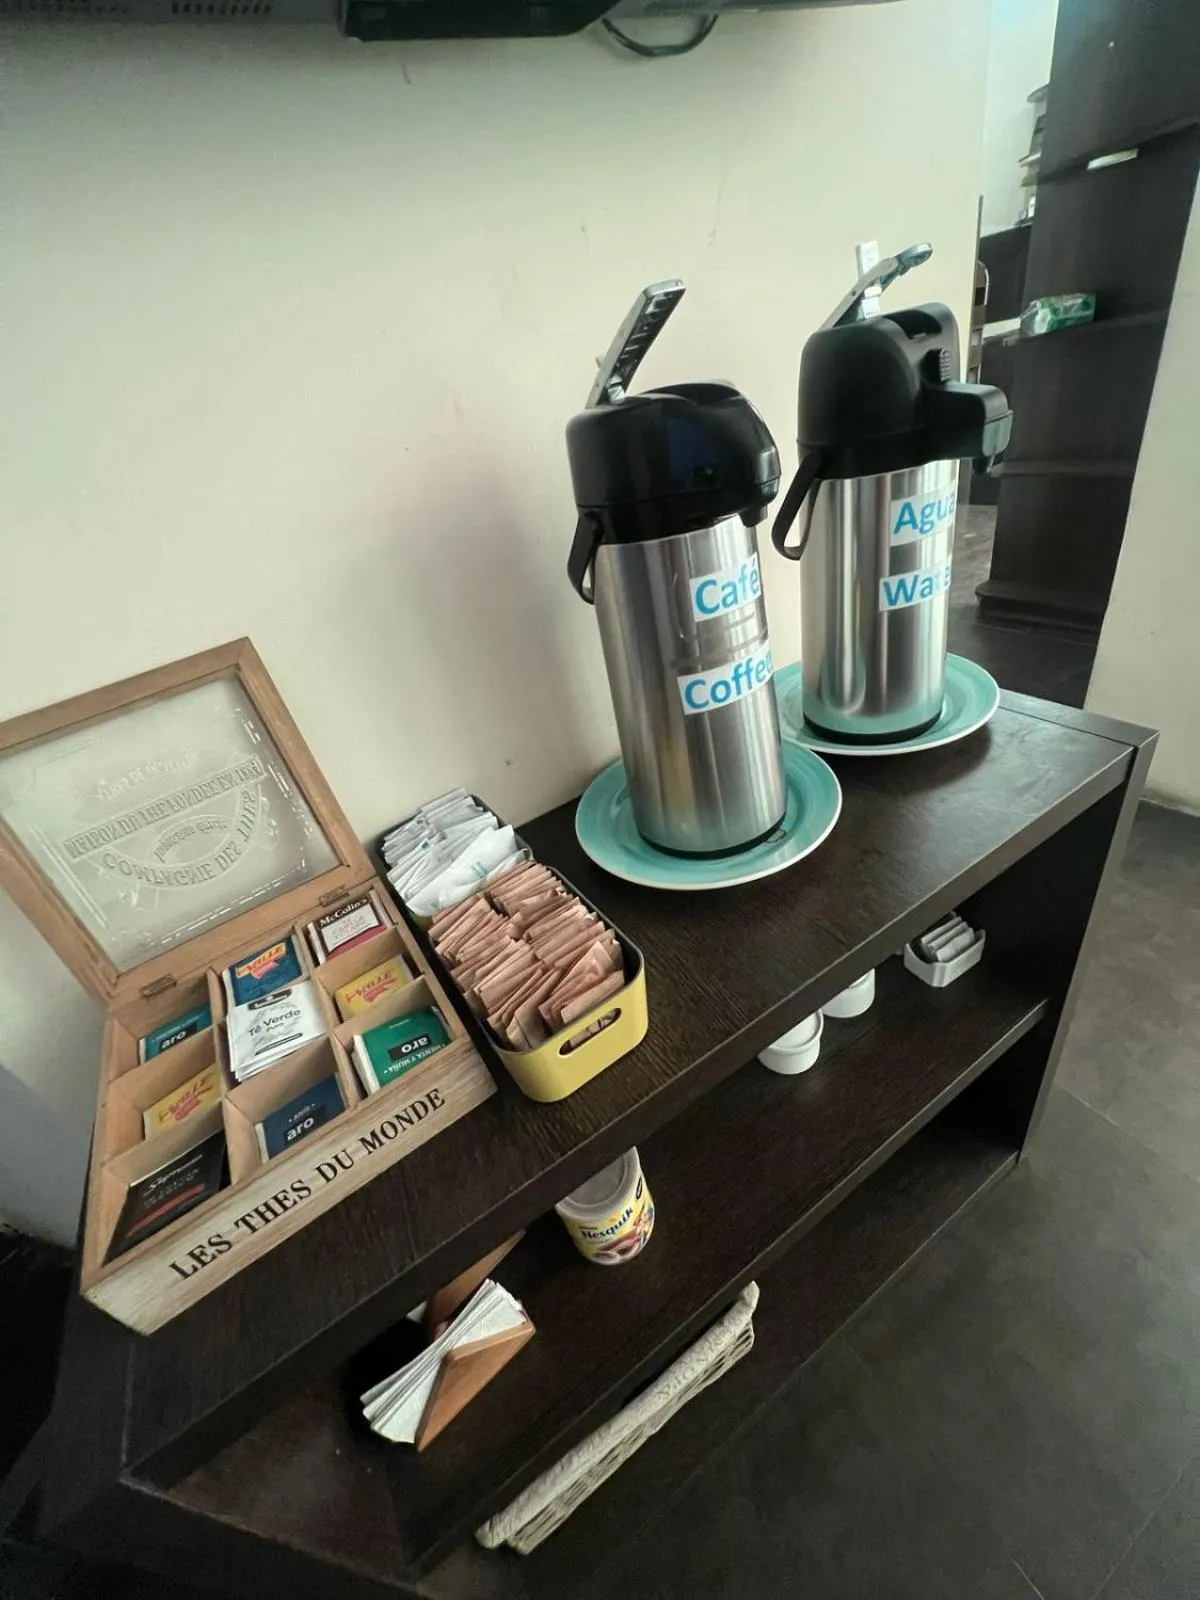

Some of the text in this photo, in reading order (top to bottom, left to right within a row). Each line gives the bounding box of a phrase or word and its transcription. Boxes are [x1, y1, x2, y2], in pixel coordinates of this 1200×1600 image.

[893, 490, 956, 534] Agua
[695, 559, 760, 615] Café
[248, 1009, 302, 1037] Té Verde
[160, 1030, 187, 1050] aro
[400, 1036, 429, 1053] aro
[287, 1117, 315, 1141] aro
[168, 1233, 233, 1280] LES
[233, 1178, 312, 1236] THES
[315, 1149, 355, 1184] DU
[358, 1087, 446, 1157] MONDE
[580, 1207, 633, 1239] Nesquik
